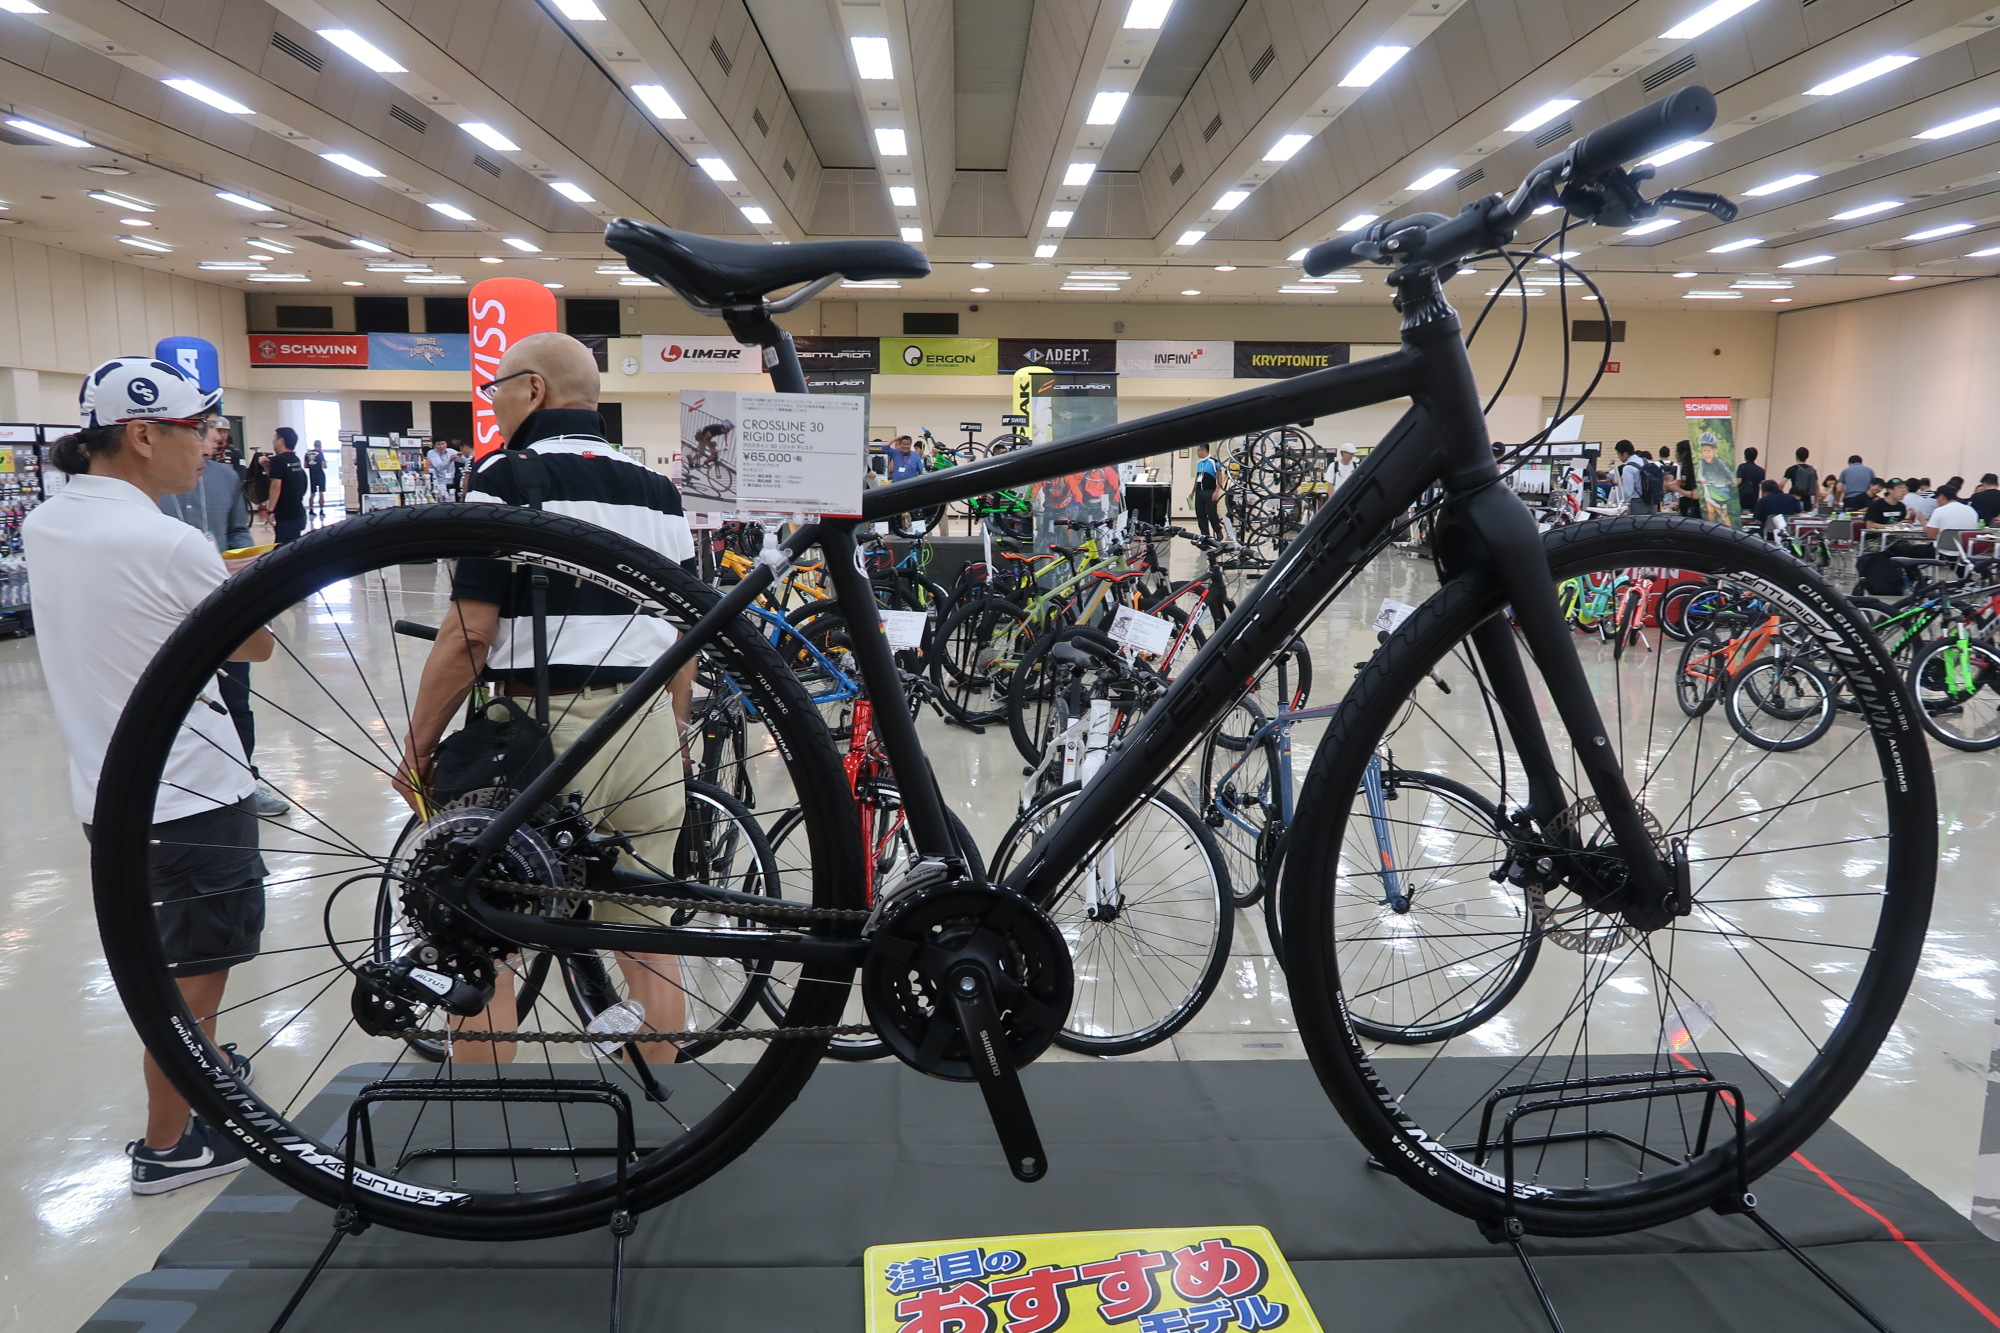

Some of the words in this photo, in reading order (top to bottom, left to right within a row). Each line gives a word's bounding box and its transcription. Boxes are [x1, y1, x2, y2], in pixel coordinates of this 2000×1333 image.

[280, 344, 358, 355] SCHWINN
[1045, 348, 1089, 361] ADEPT
[926, 355, 975, 363] ERGON
[1154, 353, 1191, 364] INFINI
[1252, 354, 1329, 367] KRYPTONITE
[126, 407, 146, 415] Cycle
[147, 406, 168, 414] Sports
[1685, 403, 1728, 412] SCHWINN
[742, 419, 806, 432] CROSSLINE
[809, 421, 824, 433] 30
[742, 432, 774, 442] RIGID
[778, 433, 805, 444] DISC
[743, 452, 792, 463] ¥65,000
[616, 563, 665, 592] City
[505, 844, 535, 879] SHIMANO
[414, 972, 447, 991] ALTUS
[170, 1015, 210, 1068] ALEXRIMS
[979, 1030, 1001, 1077] SHIMANO
[224, 1118, 269, 1154] TIOGA
[1392, 1134, 1426, 1169] TIOGA
[885, 1248, 1024, 1292] 注目の
[898, 1240, 1262, 1333] おすすめ
[1139, 1296, 1283, 1333] モデル
